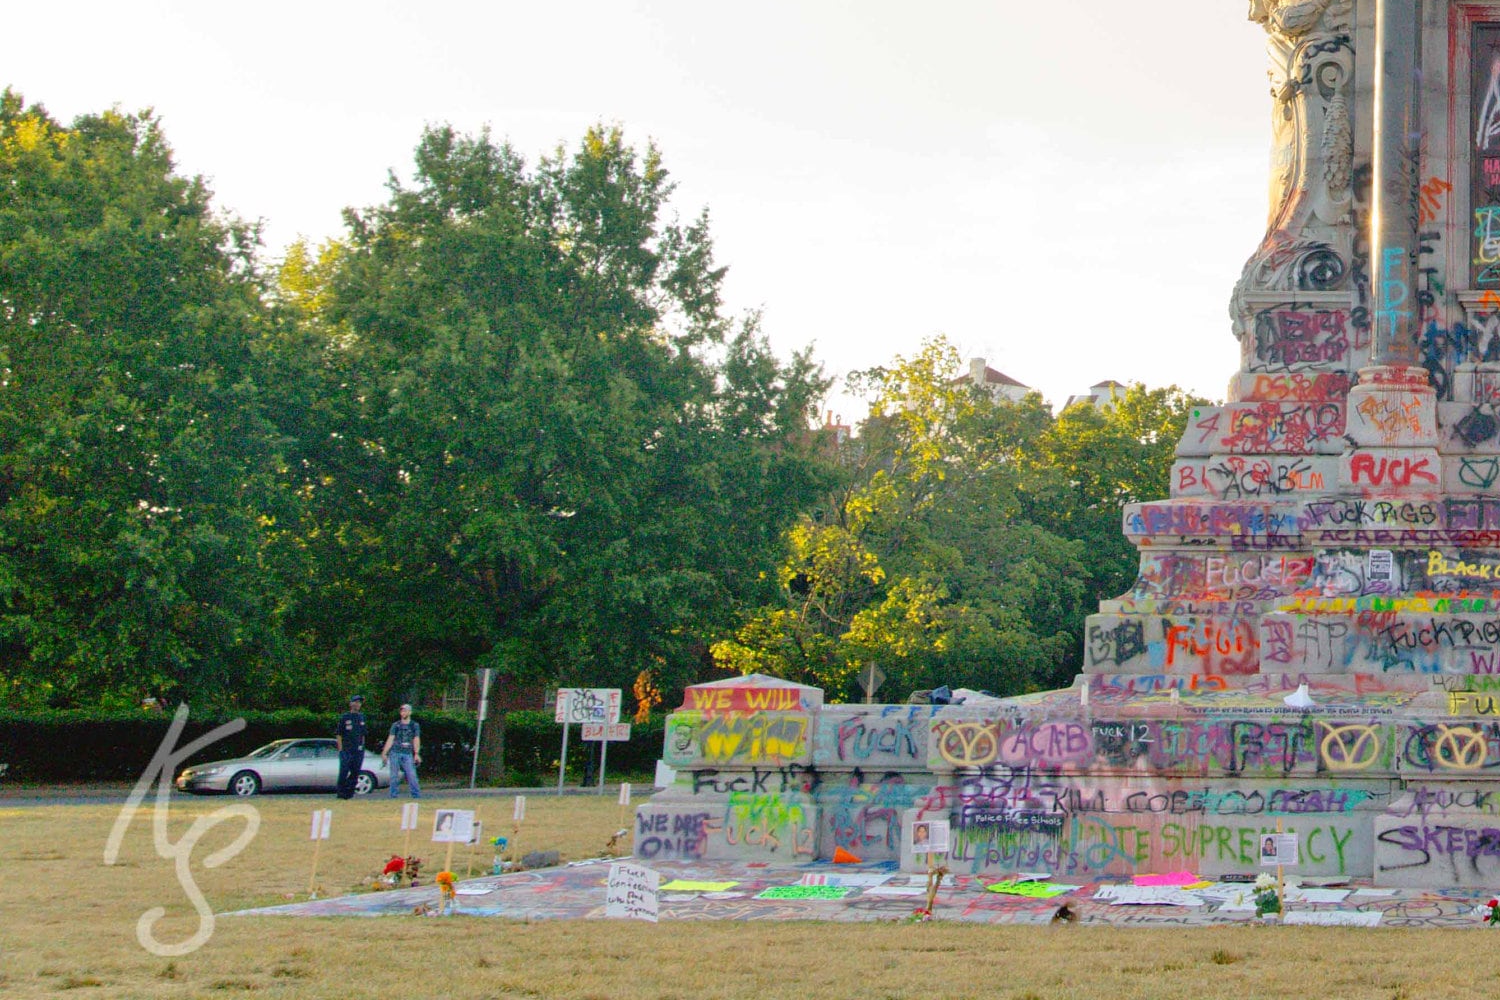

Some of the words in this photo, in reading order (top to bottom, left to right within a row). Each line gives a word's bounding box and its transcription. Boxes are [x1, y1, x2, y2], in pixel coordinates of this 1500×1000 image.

[1351, 453, 1439, 487] FUCK
[1427, 550, 1491, 580] BLACK
[691, 689, 734, 709] WE
[745, 688, 797, 711] WILL
[837, 716, 919, 762] FUCK
[1011, 723, 1090, 757] ACAB
[1091, 726, 1126, 738] FUCK
[1129, 724, 1156, 743] 12
[693, 766, 772, 794] FUCK
[637, 812, 669, 835] WE
[704, 817, 781, 848] FUCK
[639, 836, 704, 860] ONE
